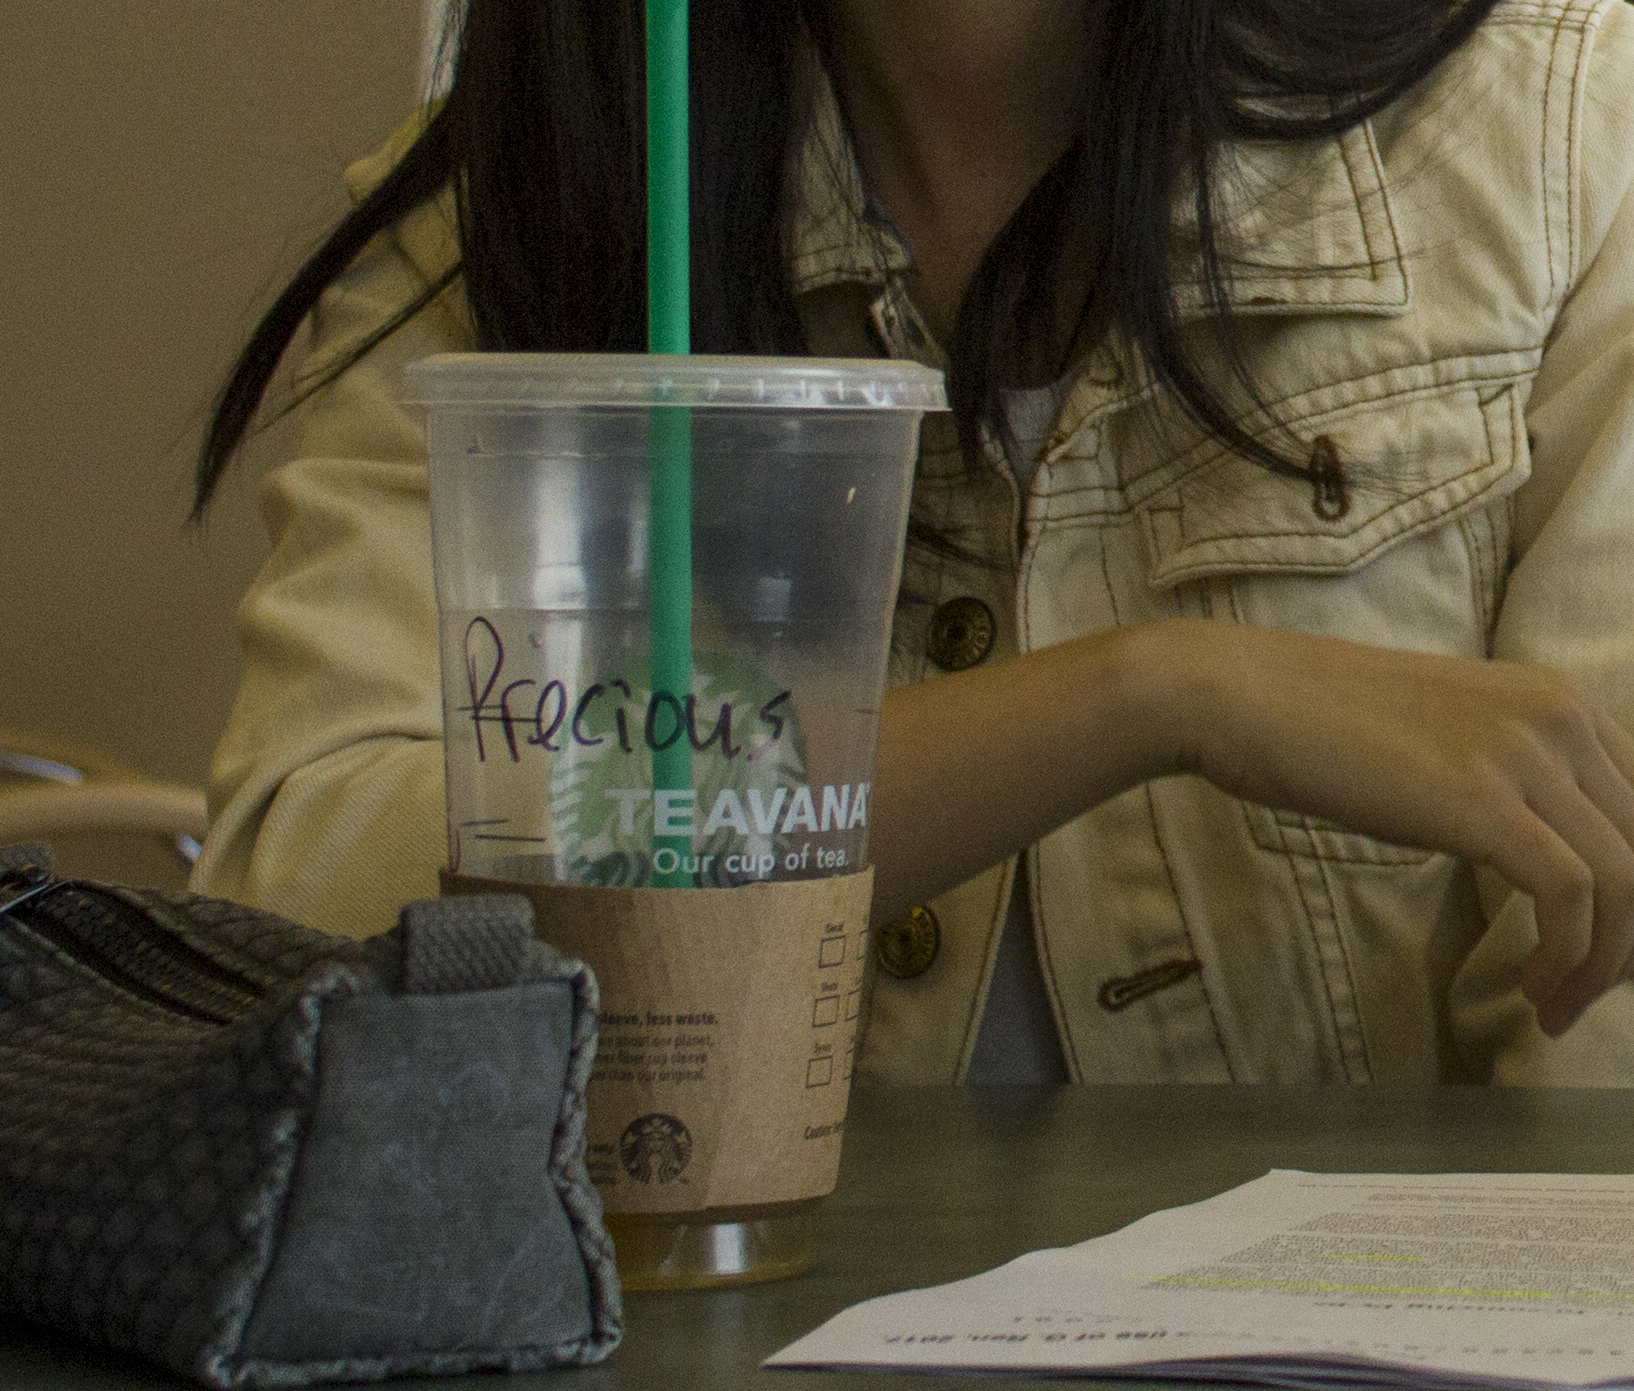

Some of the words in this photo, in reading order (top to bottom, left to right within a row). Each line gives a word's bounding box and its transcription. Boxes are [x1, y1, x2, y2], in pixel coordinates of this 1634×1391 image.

[464, 615, 793, 764] Precious
[603, 782, 869, 837] TEAVANA
[653, 847, 712, 875] Our
[725, 850, 774, 877] cup
[784, 848, 809, 872] of
[646, 1011, 673, 1026] less
[675, 1012, 719, 1026] waste.
